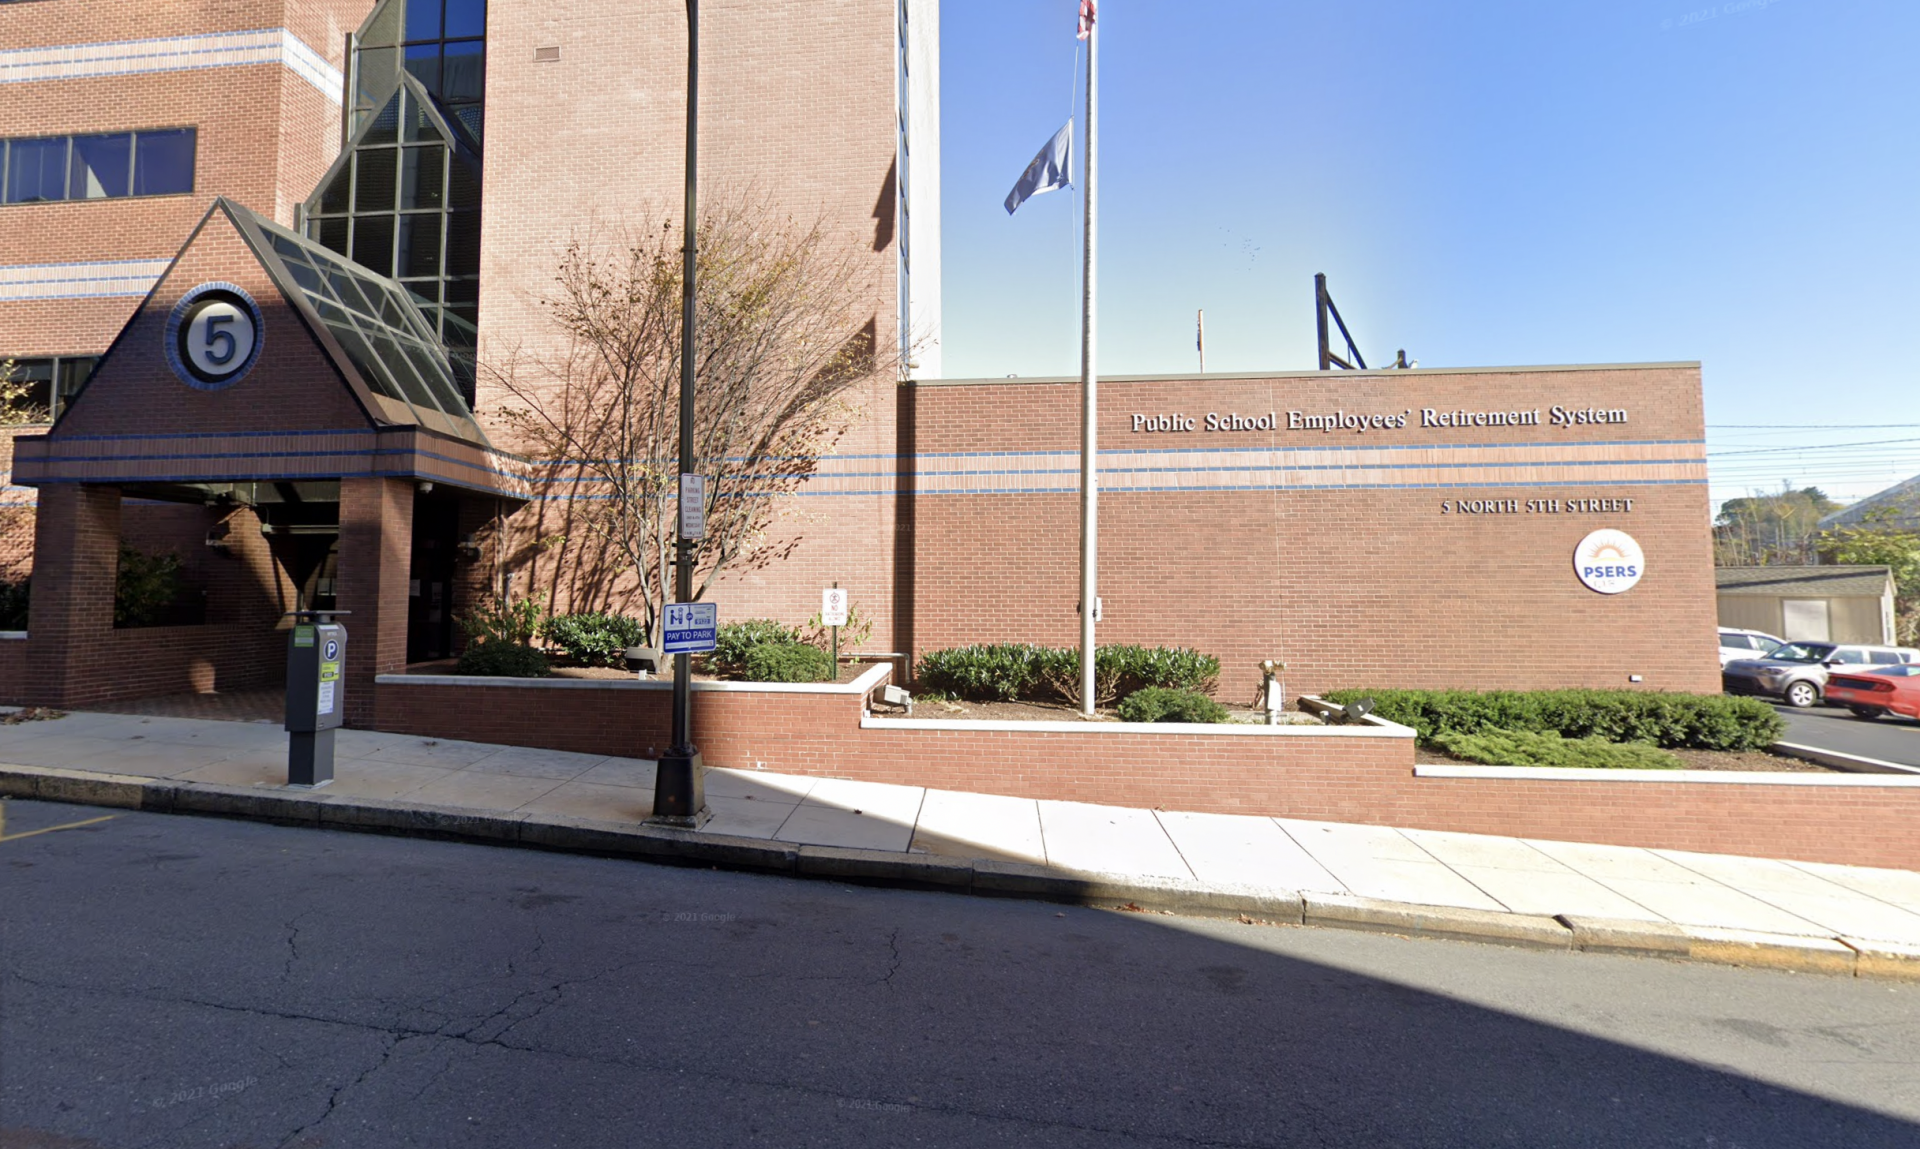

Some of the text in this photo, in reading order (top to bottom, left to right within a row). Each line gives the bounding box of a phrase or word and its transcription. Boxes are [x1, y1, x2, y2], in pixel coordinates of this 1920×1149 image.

[205, 315, 236, 365] 5
[1131, 412, 1196, 432] Public
[1204, 411, 1277, 432] School
[1420, 407, 1542, 428] Retirement
[1550, 405, 1628, 429] System
[685, 486, 701, 494] PARKING
[686, 496, 699, 504] STREET
[1441, 498, 1634, 515] 5 NORTH 5TH STREET
[684, 505, 702, 513] CLEANING
[1583, 565, 1637, 578] PSERS
[666, 630, 712, 641] PAY TO PARK
[327, 642, 336, 658] P
